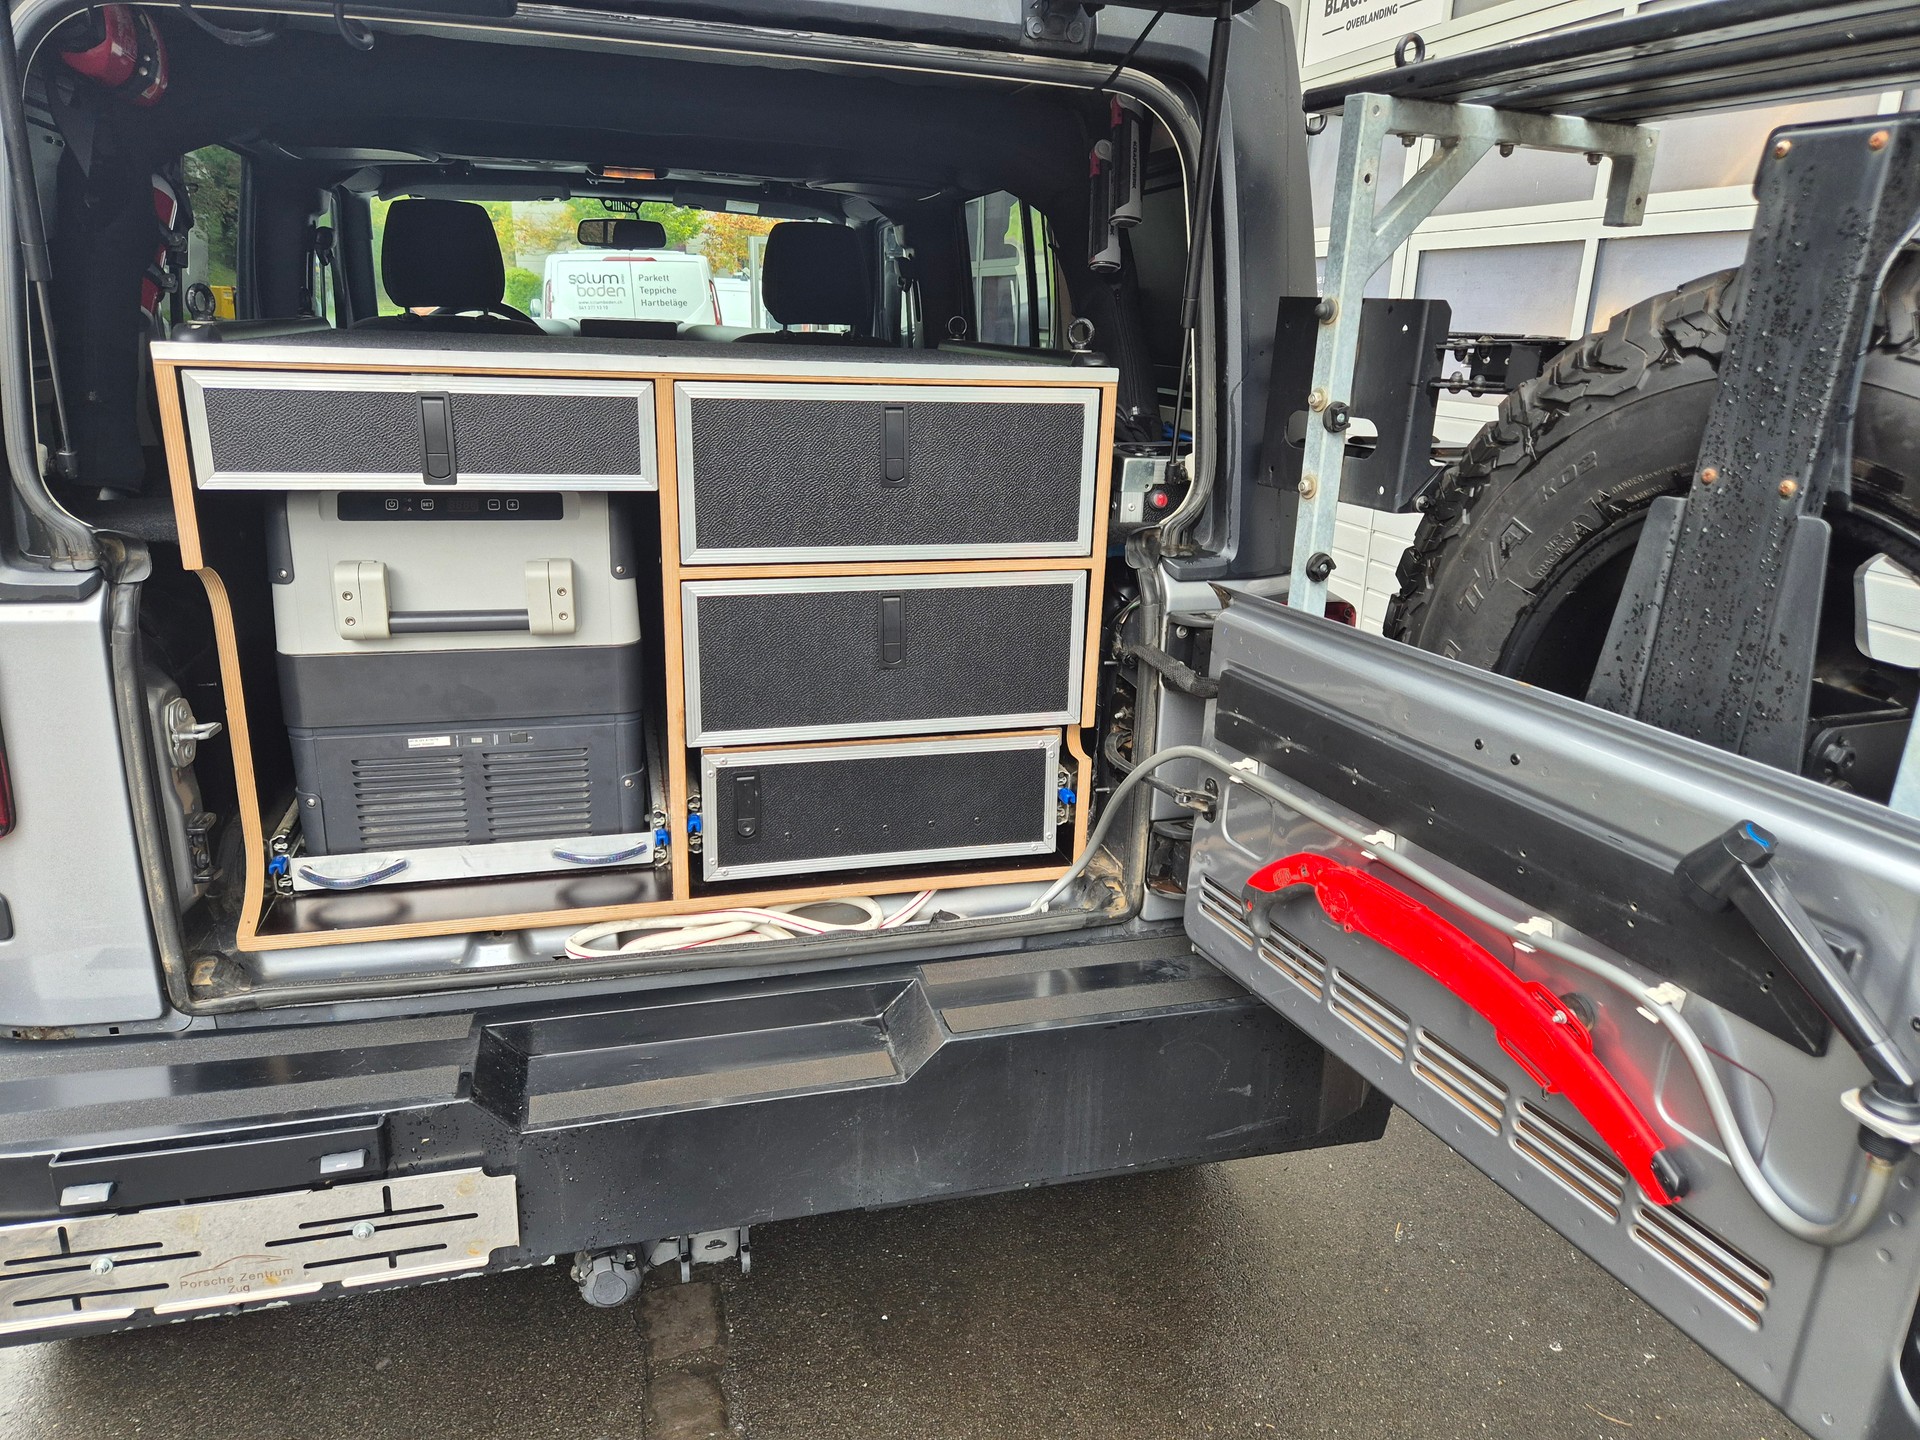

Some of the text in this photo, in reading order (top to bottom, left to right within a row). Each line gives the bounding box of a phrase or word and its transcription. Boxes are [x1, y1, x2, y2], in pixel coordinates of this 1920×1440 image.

[1324, 0, 1368, 17] BLA
[1345, 3, 1398, 31] OVERLANDING
[568, 272, 619, 284] solum
[638, 273, 670, 282] Parkett
[577, 284, 626, 297] boden
[639, 285, 677, 296] Teppiche
[641, 298, 688, 309] Hartbeläge
[180, 1268, 294, 1290] Porsche Zentrum
[228, 1284, 251, 1294] Zug
